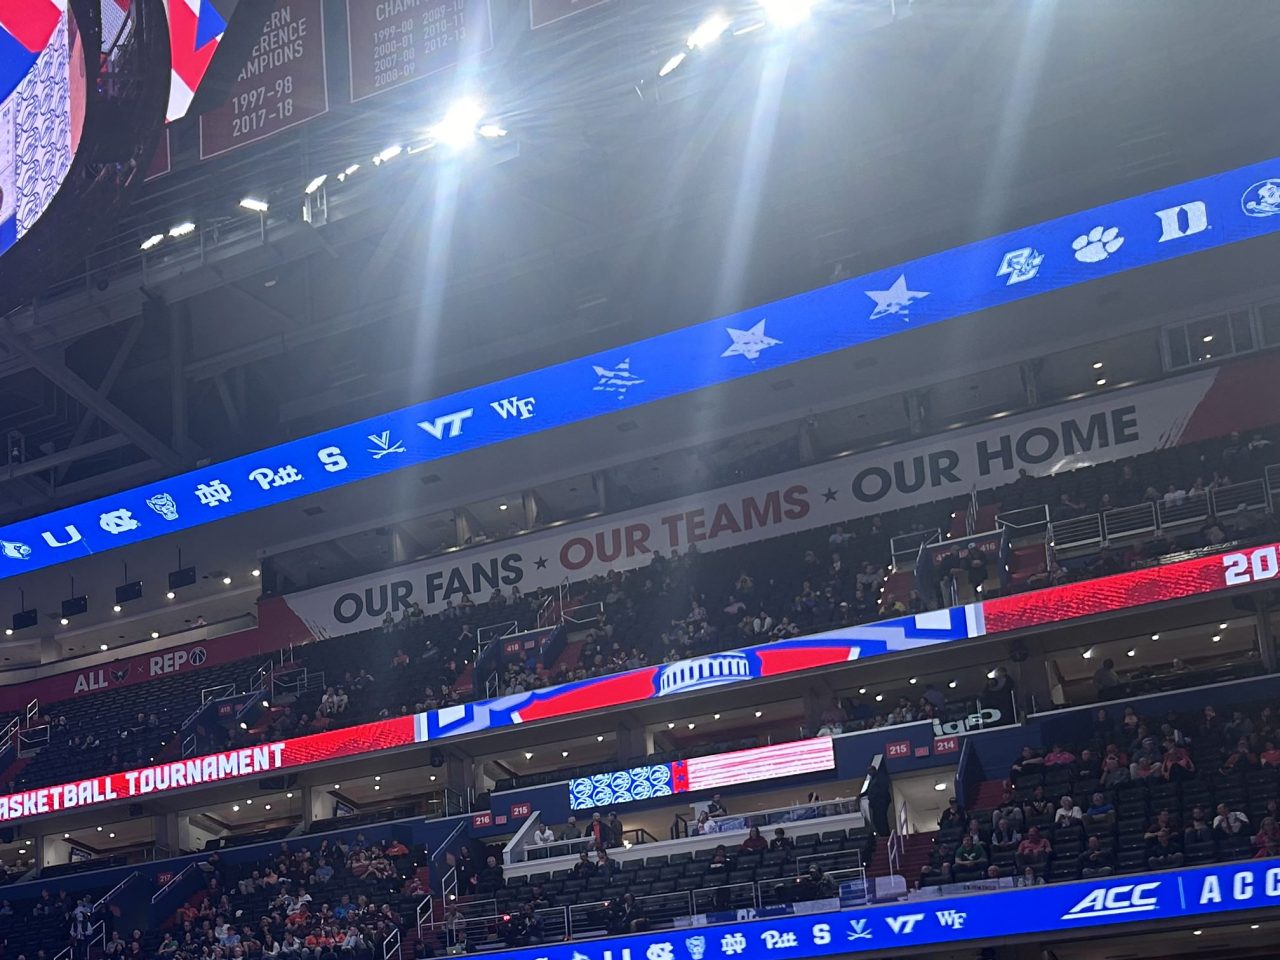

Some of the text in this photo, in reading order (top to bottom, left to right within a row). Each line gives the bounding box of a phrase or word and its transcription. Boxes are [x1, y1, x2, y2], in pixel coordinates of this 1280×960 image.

[232, 76, 293, 115] 1997-98
[232, 98, 293, 137] 2017-18
[248, 465, 302, 490] Pitt
[417, 408, 473, 440] VT
[333, 405, 1139, 624] OUR FANS OUR TEAMS OUR HOME
[1223, 547, 1279, 586] 20
[74, 652, 187, 693] ALL REP
[889, 744, 907, 754] 215
[937, 741, 954, 750] 214
[125, 743, 285, 796] TOURNAMENT
[475, 815, 490, 825] 216
[513, 806, 528, 817] 215
[1065, 882, 1161, 916] ACC
[761, 930, 798, 949] Pitt
[885, 913, 925, 934] VT
